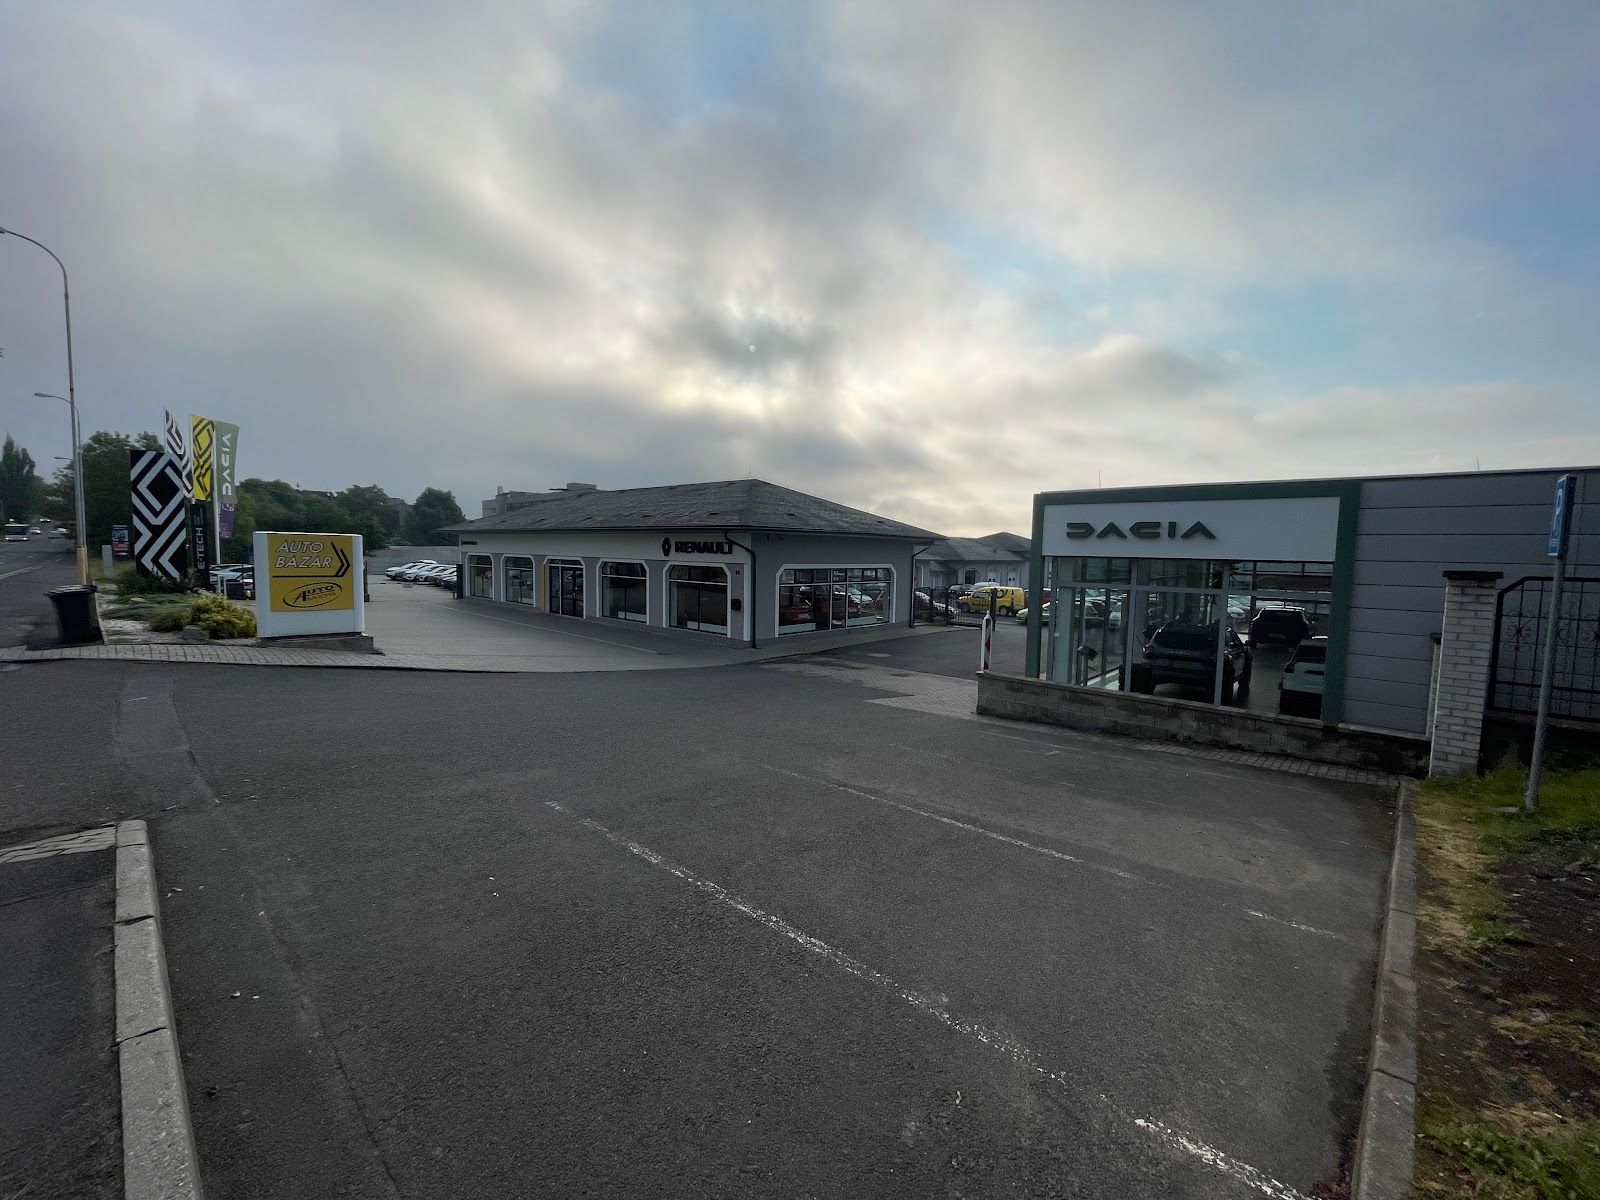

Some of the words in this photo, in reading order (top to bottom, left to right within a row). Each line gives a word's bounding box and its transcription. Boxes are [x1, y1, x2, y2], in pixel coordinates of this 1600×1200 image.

[222, 433, 232, 496] DACIA
[1066, 521, 1217, 540] DACIA
[195, 527, 206, 570] E-TECH
[276, 540, 325, 554] AUTO
[674, 540, 733, 555] RENAULT
[275, 555, 333, 569] BAZAR
